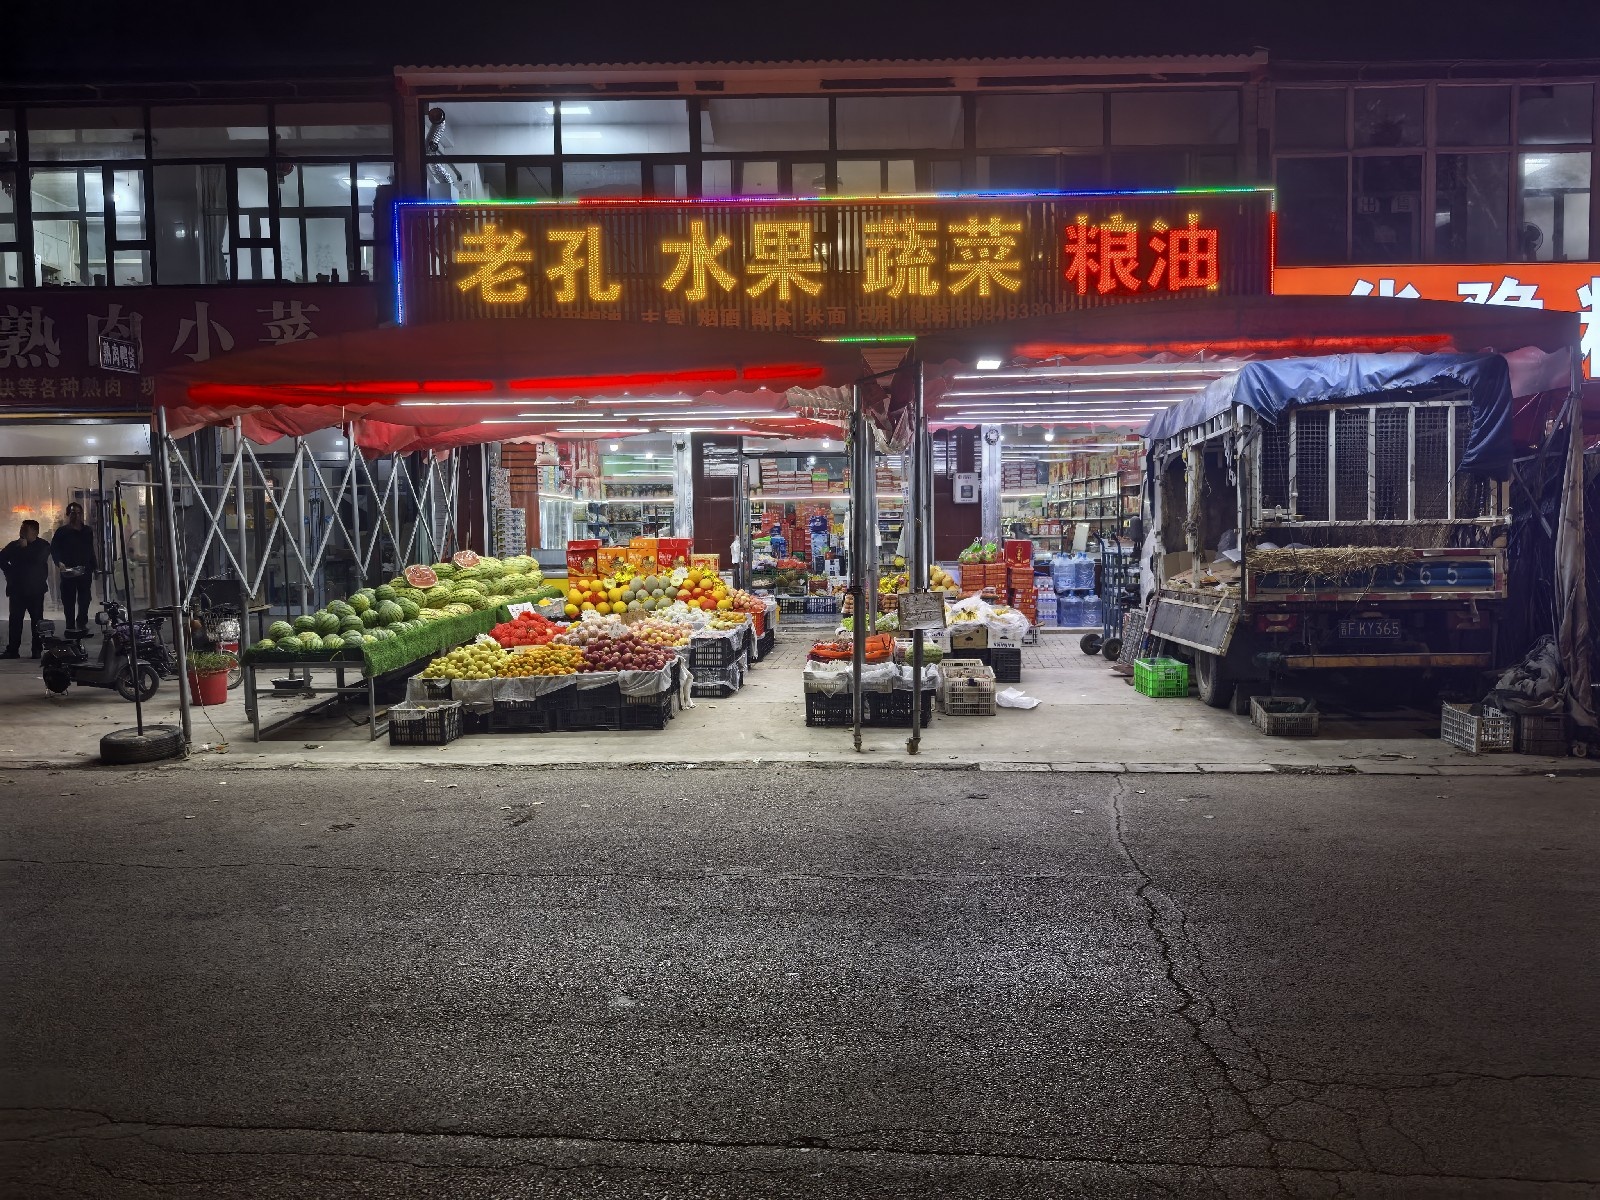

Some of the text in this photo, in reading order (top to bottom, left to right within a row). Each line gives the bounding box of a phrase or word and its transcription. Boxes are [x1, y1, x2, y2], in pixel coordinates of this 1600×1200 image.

[457, 213, 1219, 303] 老孔 水果 蔬菜 粮油
[698, 307, 741, 327] 烟酒
[751, 307, 792, 327] 副食
[805, 306, 847, 325] 米面
